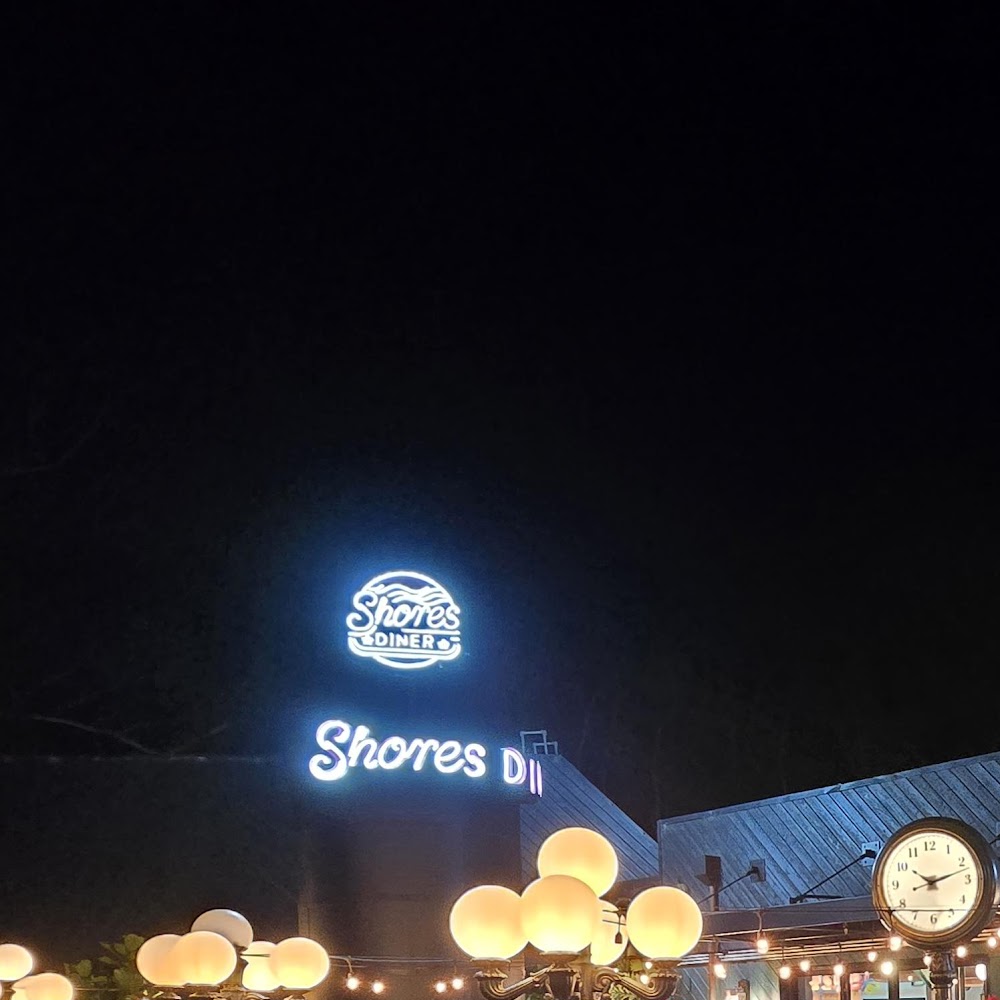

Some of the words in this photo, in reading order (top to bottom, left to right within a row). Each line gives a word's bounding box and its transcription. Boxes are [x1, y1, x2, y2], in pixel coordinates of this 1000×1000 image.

[346, 590, 460, 631] Shores
[374, 632, 434, 649] DINER
[308, 719, 487, 781] Shores
[924, 840, 936, 851] 12
[946, 844, 951, 854] 1
[908, 847, 918, 858] 11
[897, 862, 908, 872] 10
[958, 856, 965, 867] 2
[892, 880, 899, 890] 9
[965, 874, 971, 885] 3
[960, 894, 966, 904] 4
[930, 913, 938, 924] 6
